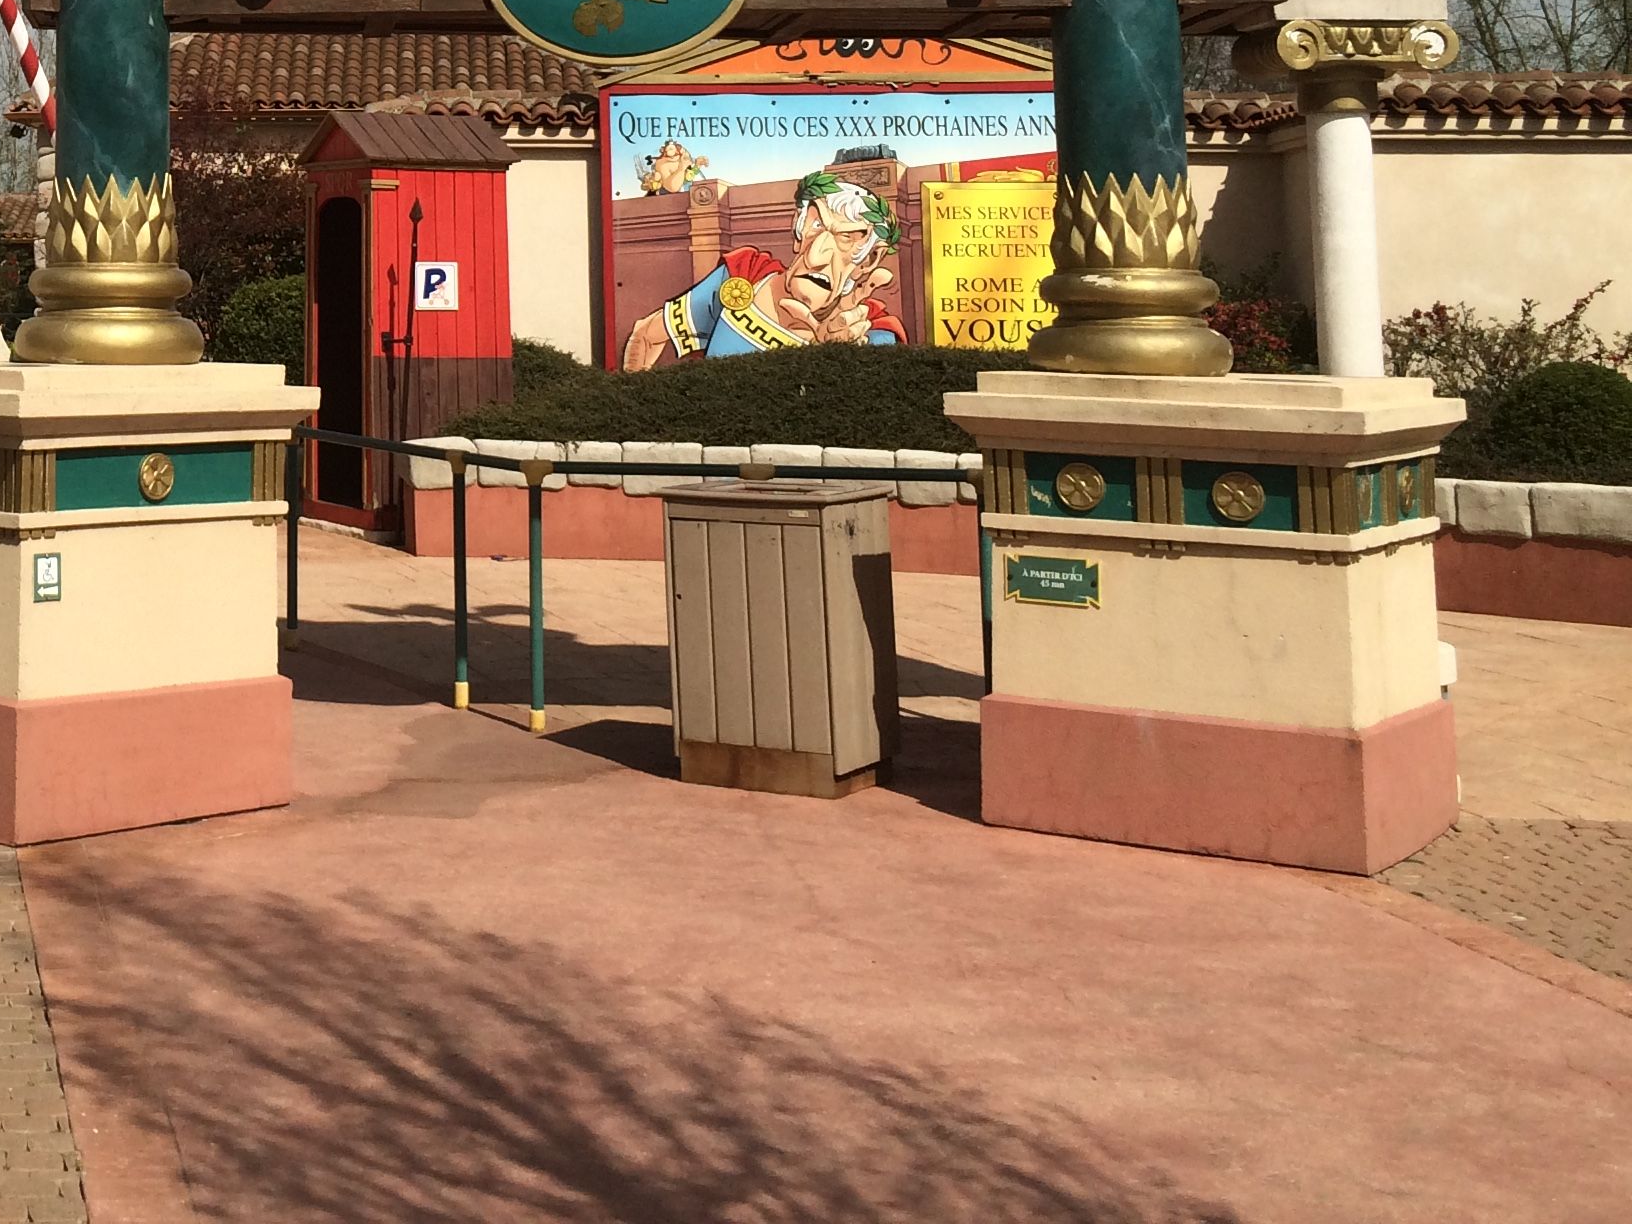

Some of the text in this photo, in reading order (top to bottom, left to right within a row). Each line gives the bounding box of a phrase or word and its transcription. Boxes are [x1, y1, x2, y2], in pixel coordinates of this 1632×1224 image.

[618, 111, 1057, 144] QUE FAITES VOUS CES XXX PROCHAINES ANN
[935, 206, 1052, 221] MES SERVICE
[961, 224, 1039, 239] SECRETS
[942, 243, 1050, 258] RECRUTENT
[423, 268, 447, 299] P
[956, 277, 1024, 293] ROME
[941, 297, 1025, 313] BESOIN
[941, 319, 1043, 344] VOUS
[1030, 570, 1061, 580] PARTIR
[1040, 579, 1050, 588] 45
